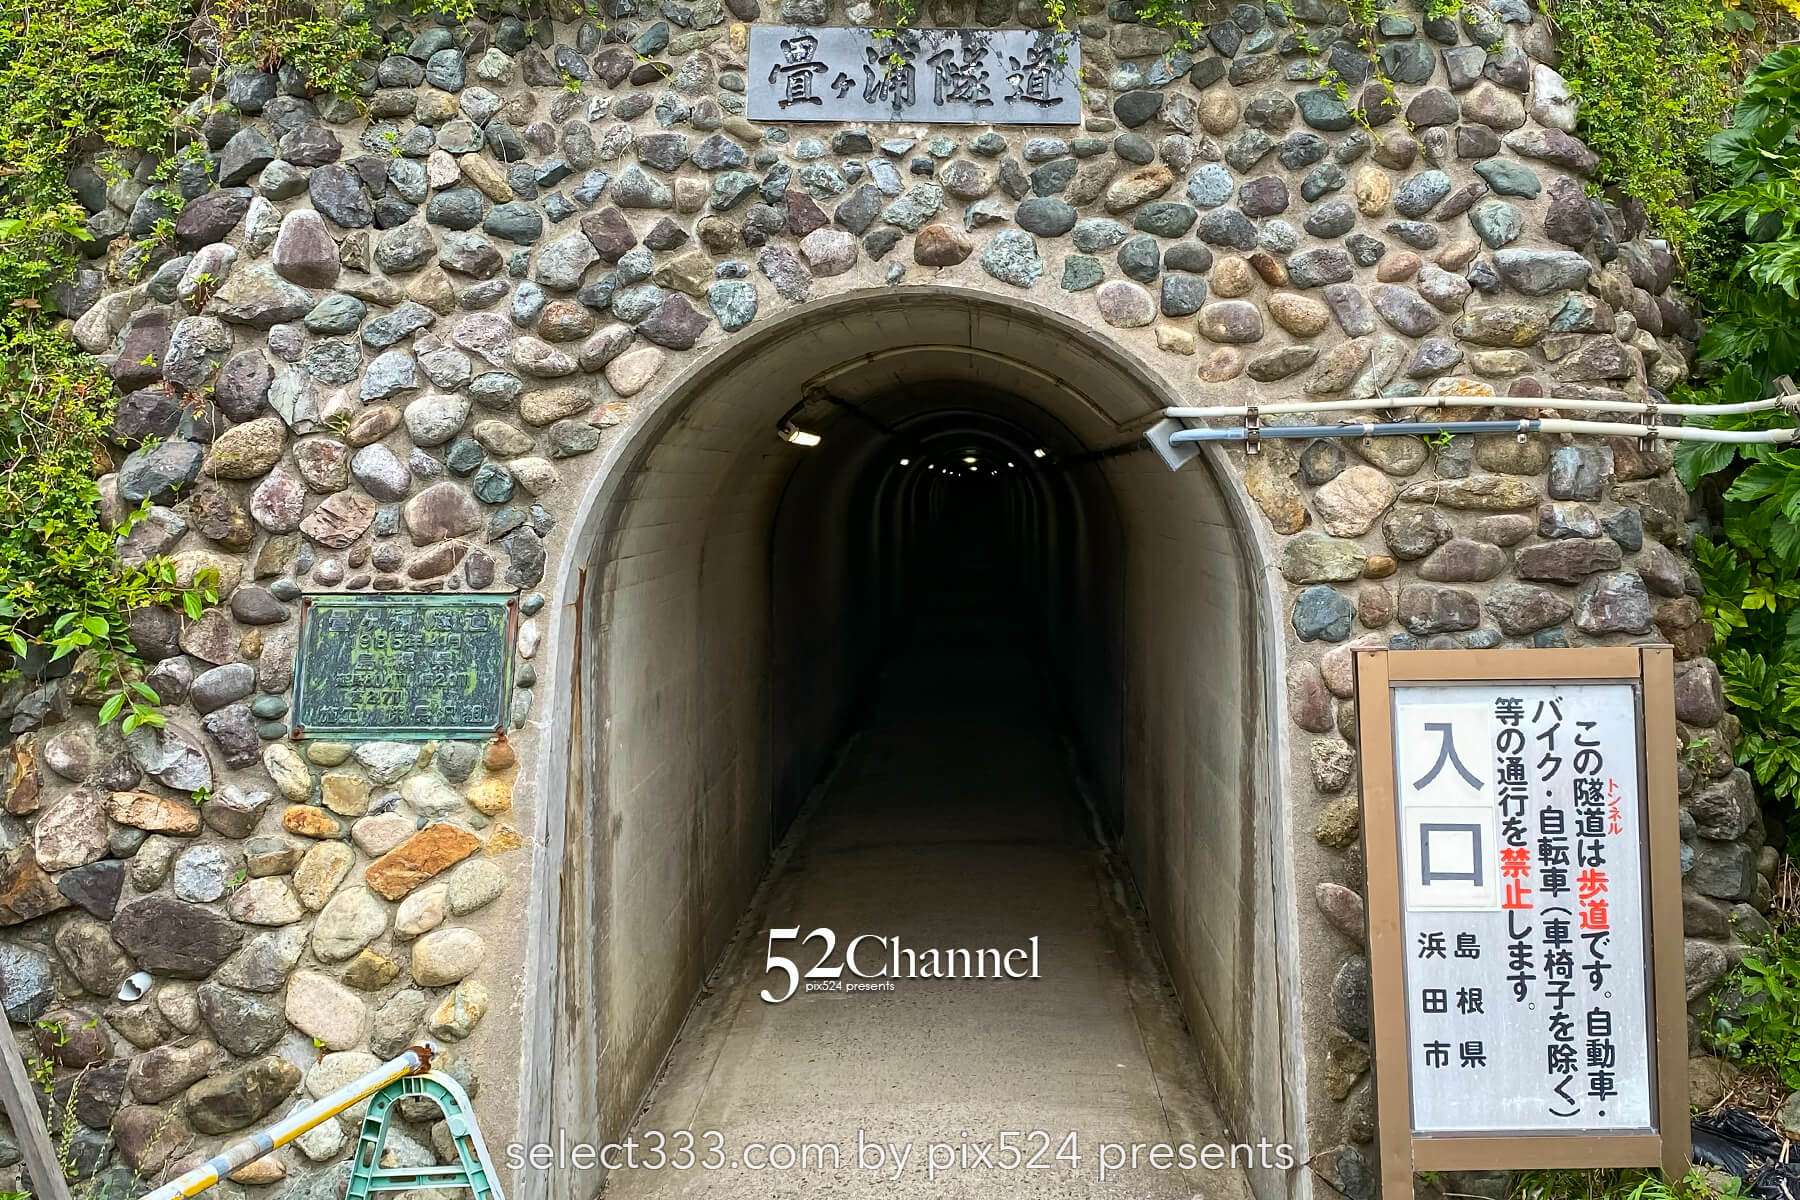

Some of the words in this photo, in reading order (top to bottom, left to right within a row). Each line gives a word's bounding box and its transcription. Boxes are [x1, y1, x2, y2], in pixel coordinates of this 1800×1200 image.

[1412, 722, 1485, 887] 入口
[1607, 778, 1623, 836] トンネル
[1417, 931, 1451, 1069] 浜田市
[1454, 931, 1487, 1068] 島根県
